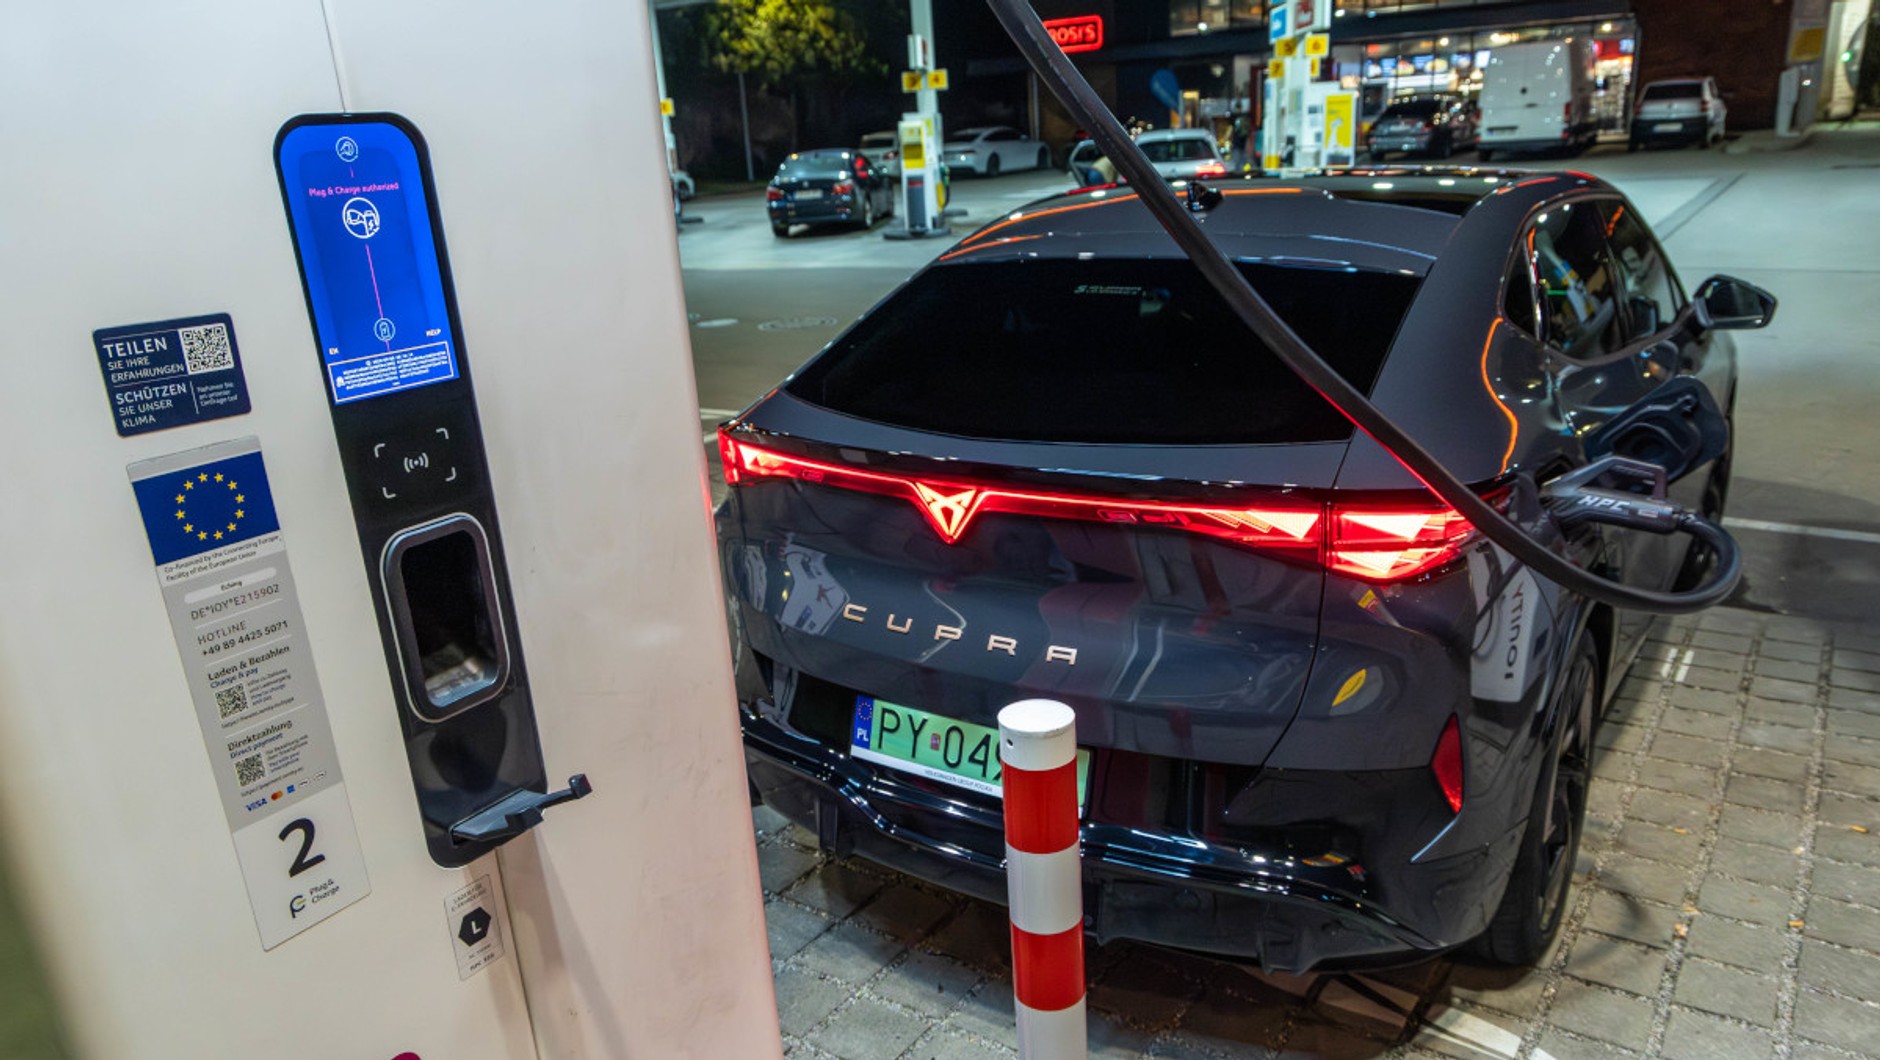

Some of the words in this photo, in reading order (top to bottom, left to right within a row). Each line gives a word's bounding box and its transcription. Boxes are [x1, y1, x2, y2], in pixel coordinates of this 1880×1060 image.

[308, 187, 327, 198] Plug
[327, 186, 334, 195] &
[335, 184, 361, 195] Charge
[362, 182, 399, 192] authorized
[102, 337, 168, 359] TEILEN
[108, 361, 124, 371] SIE
[125, 356, 150, 368] IHRE
[111, 363, 185, 383] ERFAHRUNGEN
[116, 382, 187, 405] SCHÜTZEN
[119, 406, 136, 416] SIE
[138, 399, 173, 413] UNSER
[122, 415, 156, 428] KLIMA
[1578, 495, 1631, 511] HPC
[166, 570, 190, 582] Facility
[208, 555, 238, 571] European
[238, 550, 257, 562] Union
[197, 620, 248, 645] HOTLINE
[202, 644, 221, 656] +49
[223, 638, 236, 651] 89
[237, 628, 263, 645] 4425
[264, 620, 289, 636] 5071
[842, 603, 1078, 665] CUPRA
[208, 664, 238, 681] Laden
[239, 660, 248, 670] &
[248, 645, 290, 667] Bezahlen
[210, 673, 238, 689] Charge
[245, 667, 259, 678] pay
[227, 720, 293, 751] Direktzahlung
[857, 727, 870, 742] PL
[878, 707, 928, 759] PY
[230, 745, 252, 759] Direct
[253, 733, 284, 752] payment
[246, 798, 268, 812] VISA
[278, 817, 326, 878] 2
[311, 885, 340, 904] Charge
[471, 920, 482, 935] L
